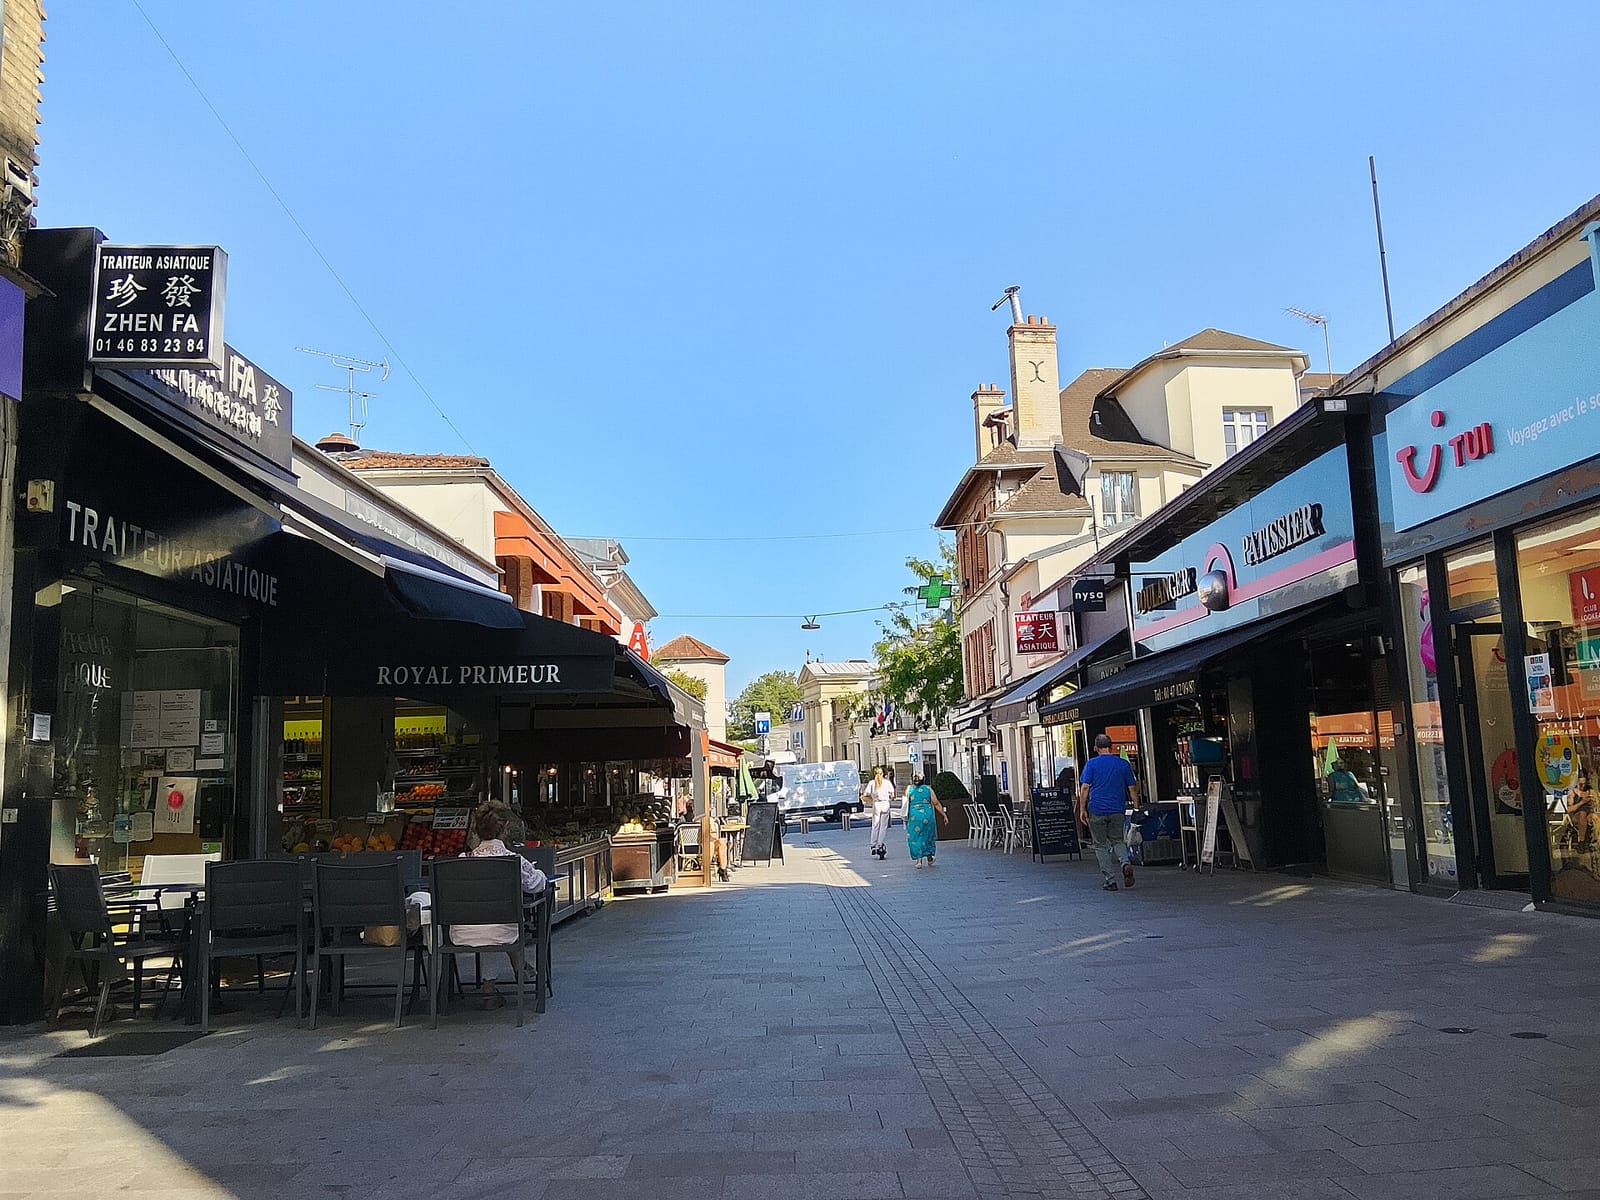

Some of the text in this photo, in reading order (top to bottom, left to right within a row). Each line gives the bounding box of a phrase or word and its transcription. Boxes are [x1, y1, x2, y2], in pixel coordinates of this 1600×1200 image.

[102, 255, 210, 271] TRAITEUR ASIATIQUE
[103, 313, 200, 333] ZHEN FA
[96, 338, 205, 352] 01 46 83 23 84
[1506, 418, 1548, 446] Voyagez
[1550, 405, 1575, 427] avec
[1575, 397, 1587, 415] le
[1448, 422, 1493, 467] TUI
[66, 500, 278, 606] TRAITEUR ASIATIQUE
[1138, 569, 1195, 613] BOULANGER
[1014, 613, 1054, 622] TRAITEUR
[1018, 641, 1057, 651] ASIATIQUE
[376, 664, 561, 685] ROYAL PRIMEUR
